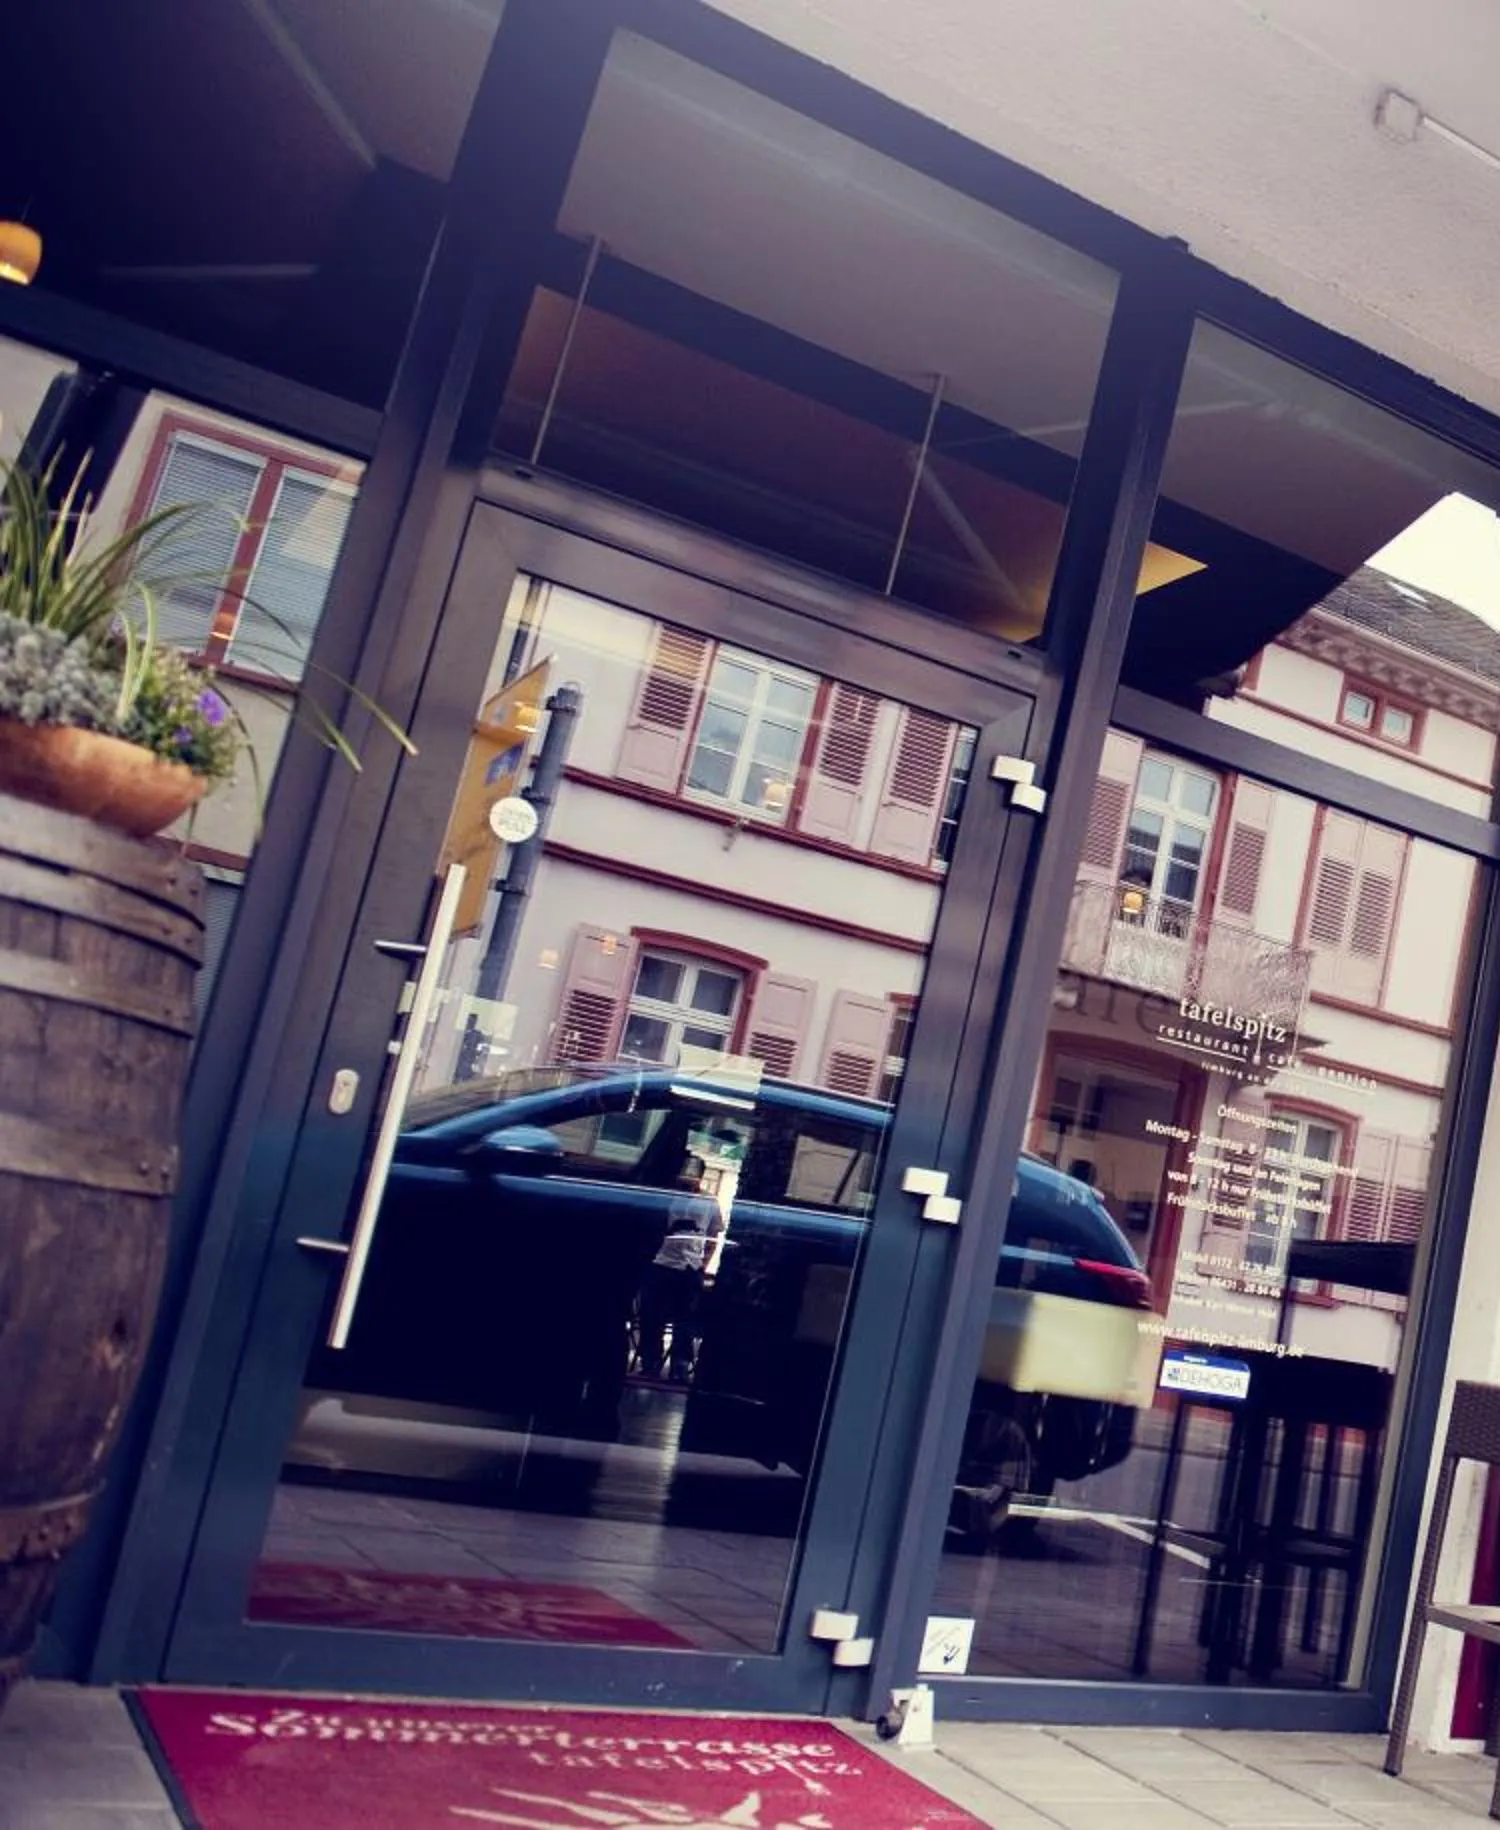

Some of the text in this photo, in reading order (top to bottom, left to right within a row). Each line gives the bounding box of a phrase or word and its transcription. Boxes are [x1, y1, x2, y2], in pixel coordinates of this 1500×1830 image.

[1178, 997, 1287, 1043] tafelspitz
[1158, 1024, 1250, 1056] restaurant
[1145, 1119, 1191, 1143] Montag
[1168, 1170, 1188, 1182] von
[204, 1713, 836, 1757] Sommerterrasse
[529, 1750, 864, 1777] tafelspitz
